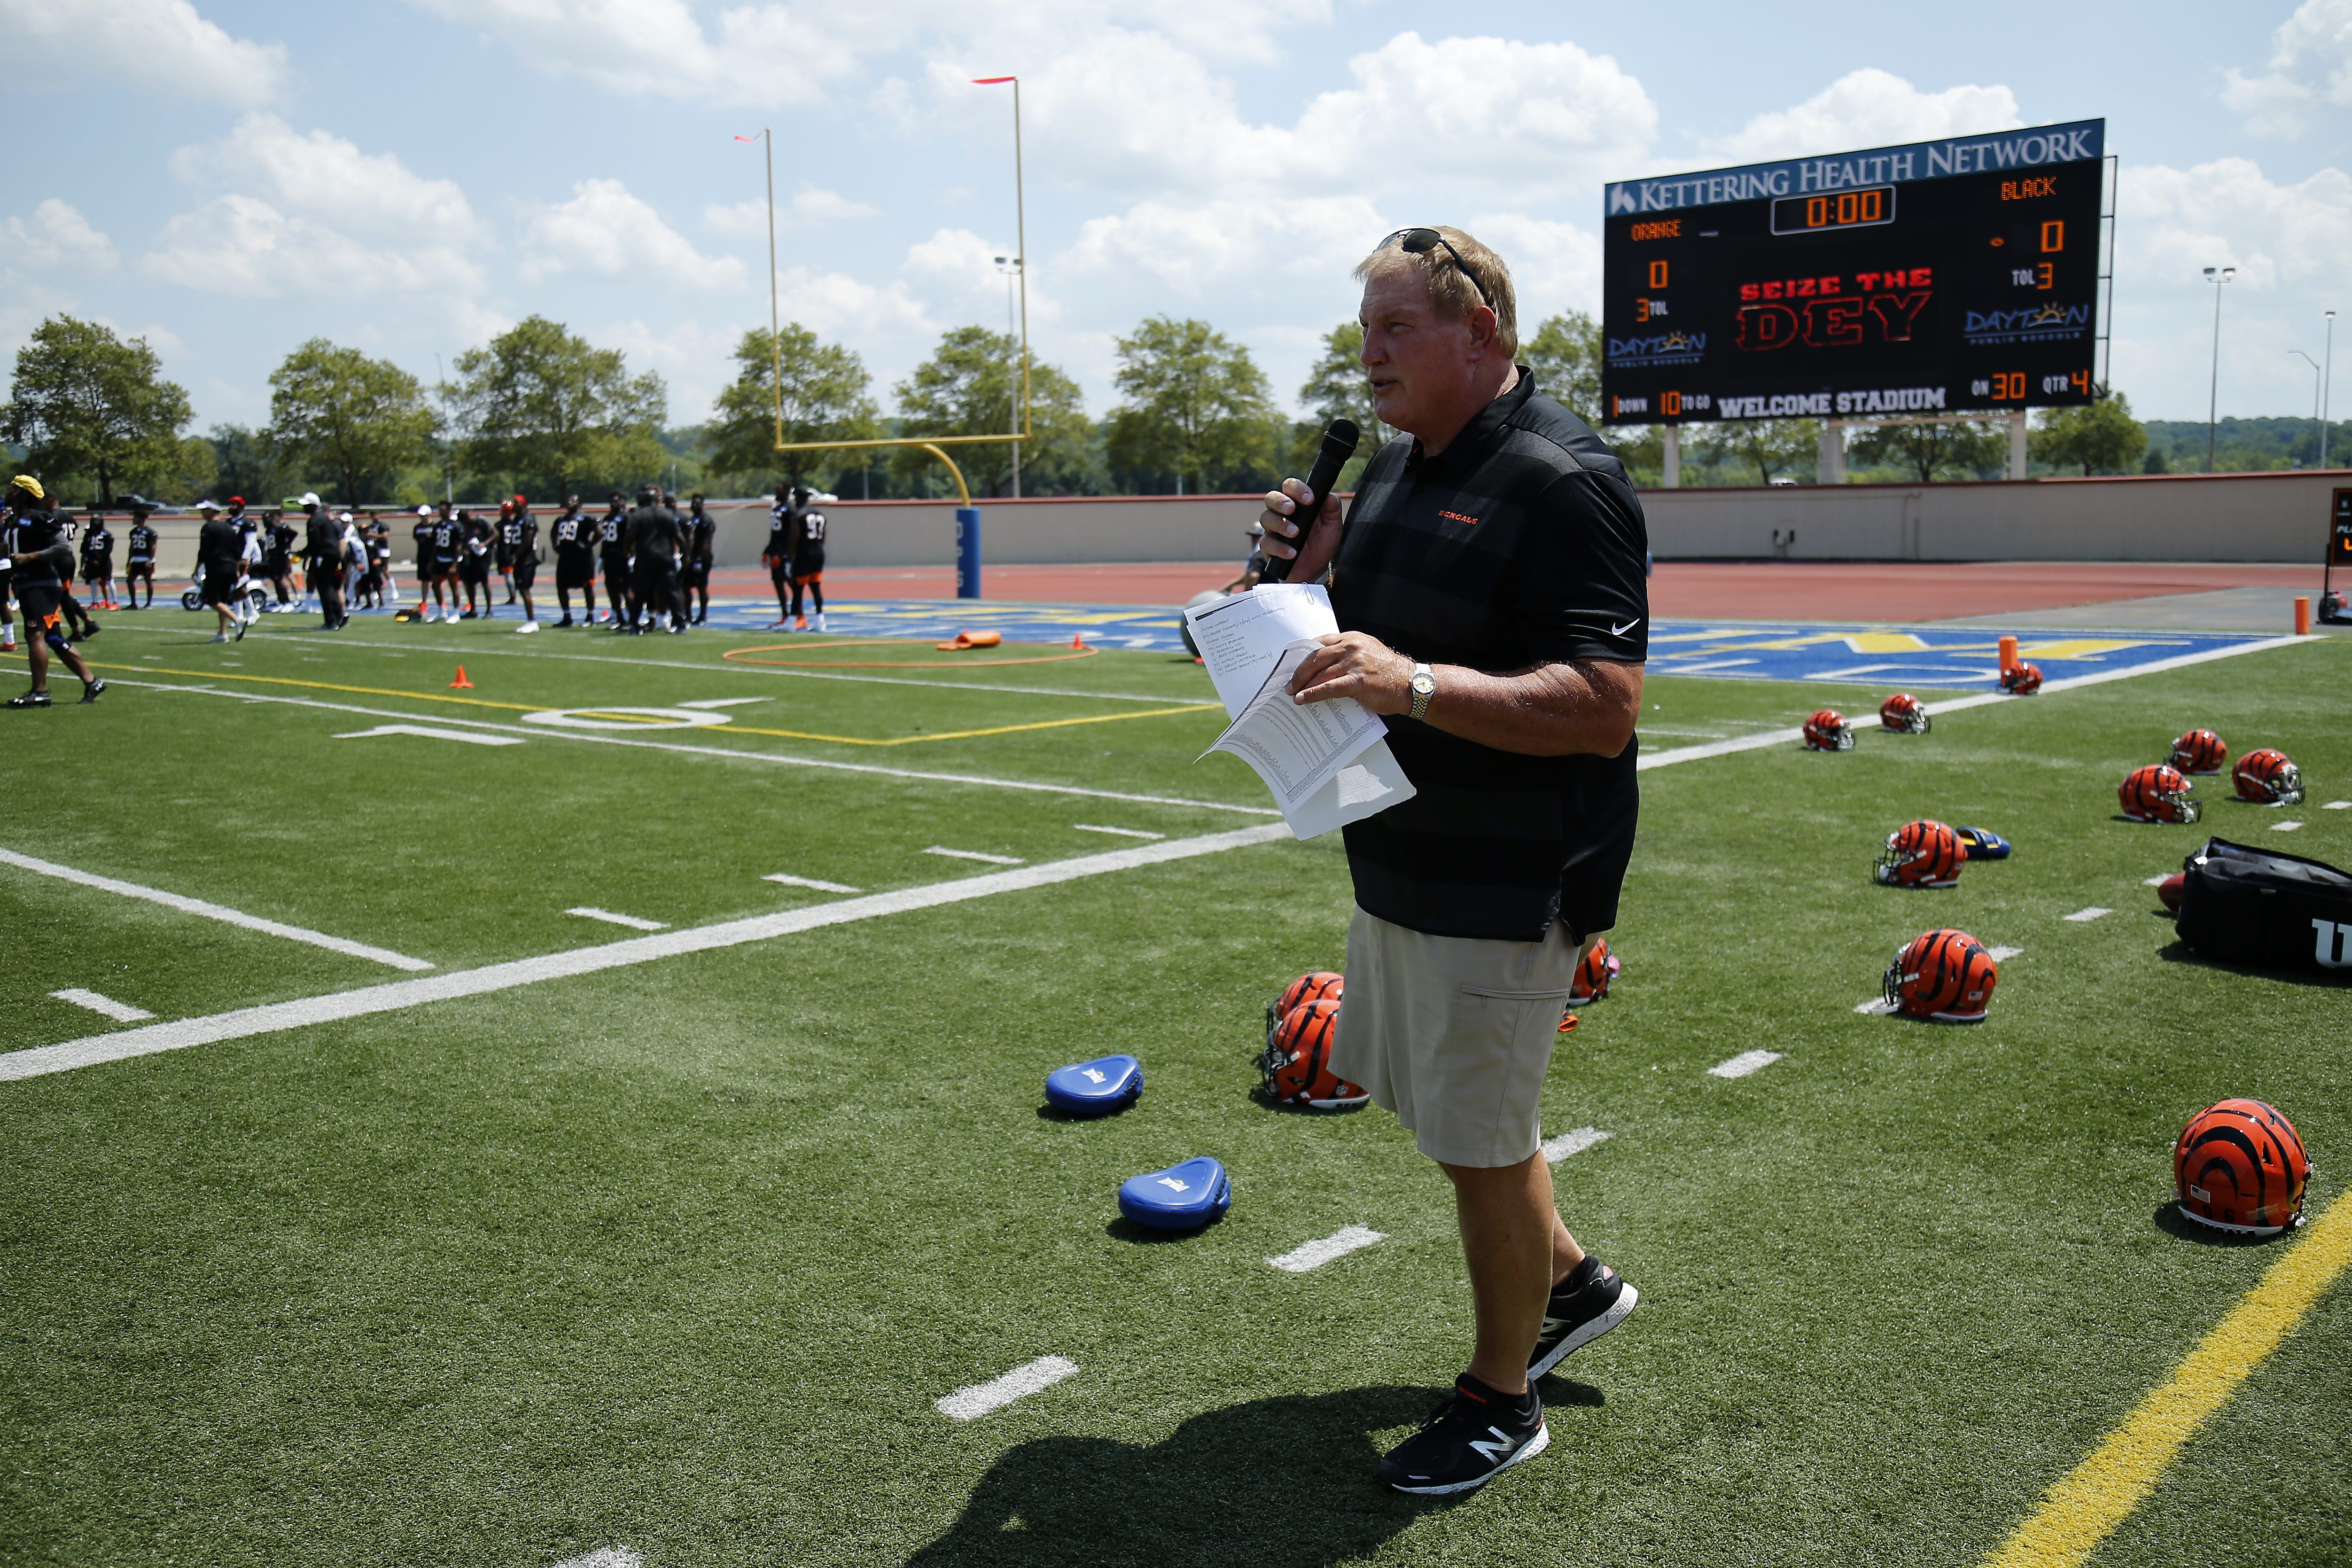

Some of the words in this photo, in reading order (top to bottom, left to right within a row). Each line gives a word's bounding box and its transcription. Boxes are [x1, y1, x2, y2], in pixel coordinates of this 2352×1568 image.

[1640, 171, 1790, 211] KETTERING
[1799, 152, 1916, 193] HEALTH
[1926, 130, 2093, 177] NETWORK
[2001, 175, 2057, 200] BLACK
[1807, 190, 1881, 227] 0:00
[1631, 219, 1682, 241] ORANGE
[2040, 220, 2064, 253] 0
[1649, 260, 1668, 289] 0
[1740, 276, 1841, 301] SEIZE
[1856, 268, 1932, 291] THE
[2011, 269, 2036, 286] TOL
[2036, 263, 2053, 289] 3
[1636, 298, 1649, 322] 3
[1649, 301, 1668, 316] TOL
[1736, 290, 1933, 351] DEY
[1972, 378, 1989, 396] ON
[1991, 372, 2026, 399] 30
[2043, 375, 2068, 393] QTR
[2072, 369, 2088, 395] 4
[1618, 398, 1647, 413] DOWN
[1661, 391, 1681, 416] 10
[1718, 394, 1832, 419] WELCOME
[1836, 387, 1946, 413] STADIUM
[1438, 510, 1478, 524] BENGALS
[2336, 525, 2352, 533] PL
